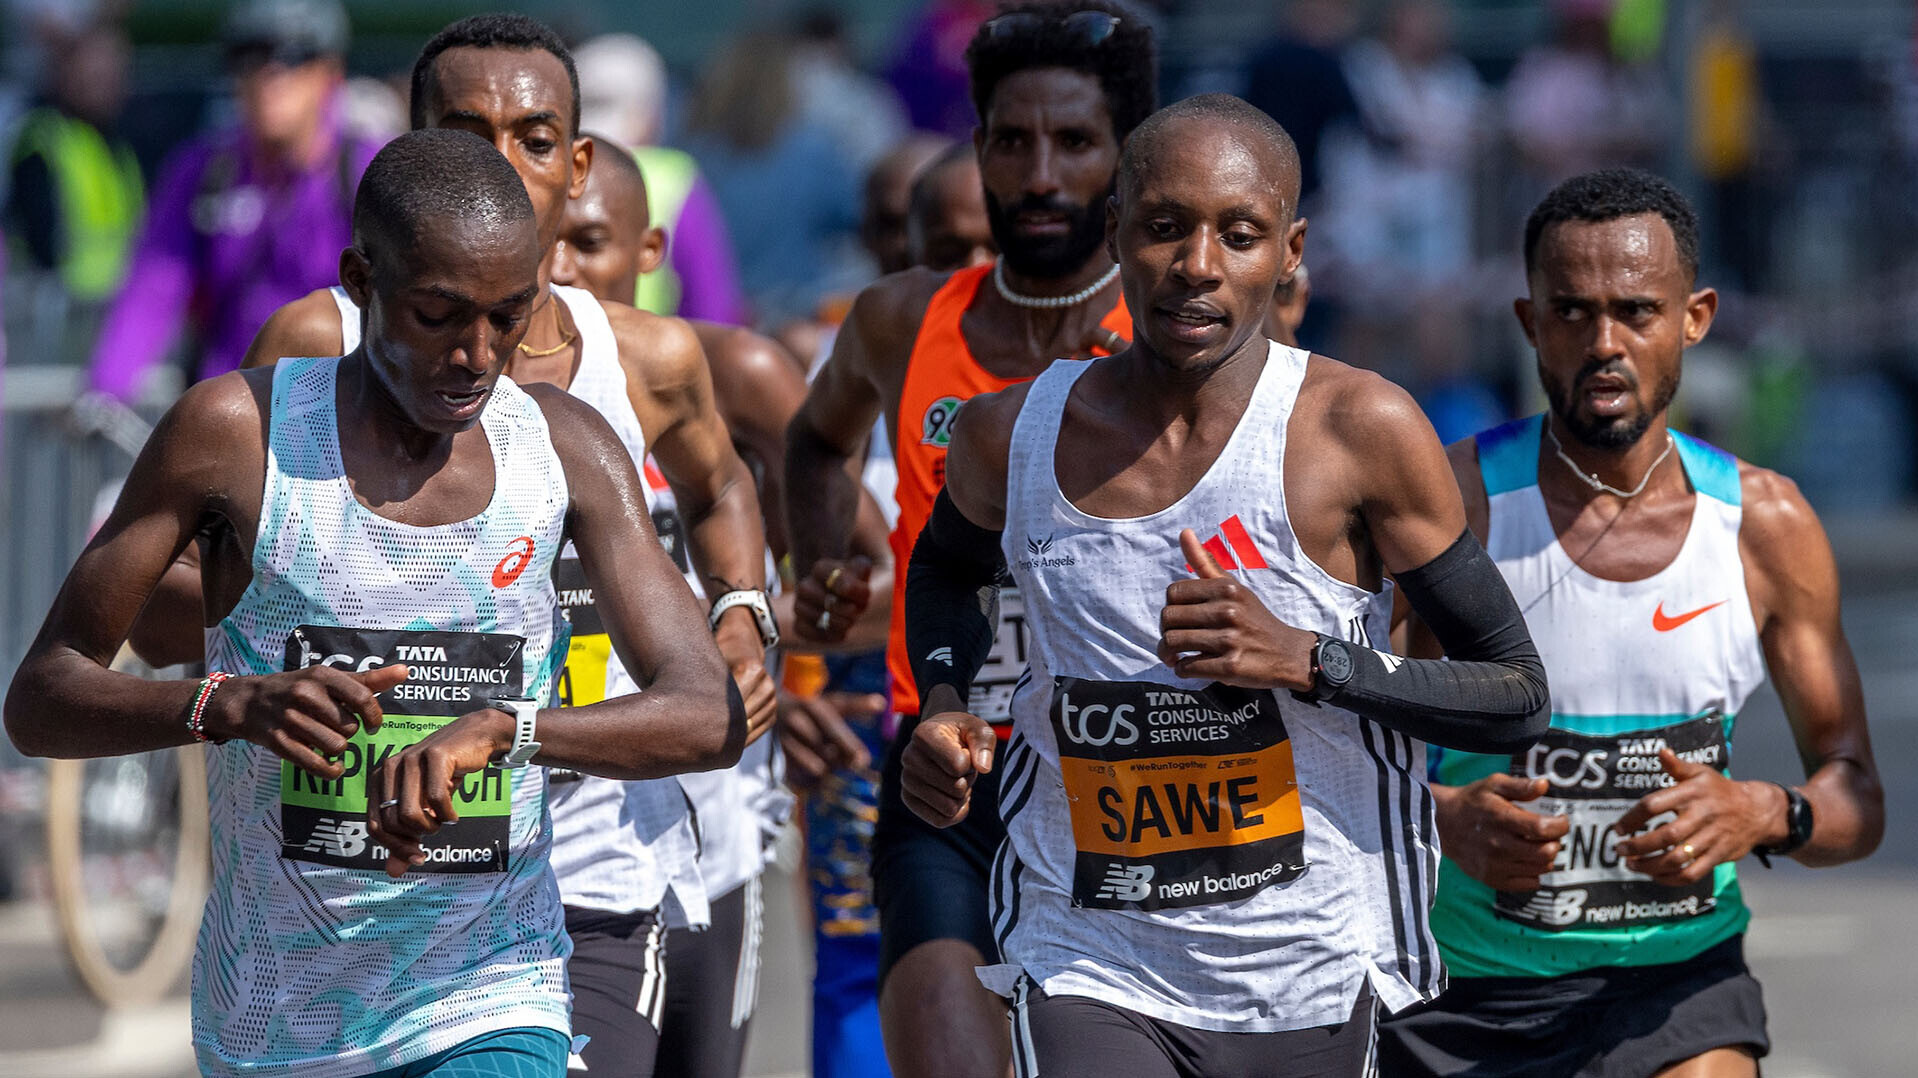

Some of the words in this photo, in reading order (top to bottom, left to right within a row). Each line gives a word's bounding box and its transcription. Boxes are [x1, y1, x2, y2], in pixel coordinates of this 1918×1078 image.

[1040, 555, 1075, 568] Angels
[396, 646, 447, 662] TATA
[406, 665, 510, 685] ONSULTANCY
[393, 684, 471, 702] SERVICES
[1145, 692, 1199, 707] TATA
[1062, 693, 1140, 747] tcs
[1147, 700, 1260, 727] CONSULTANCY
[1150, 725, 1230, 744] SERVICES
[1130, 761, 1208, 772] #WeRunTogether
[1097, 775, 1265, 843] SAWE
[1159, 880, 1201, 899] new
[1204, 862, 1283, 894] balance
[1585, 904, 1624, 923] new
[1624, 895, 1699, 920] balance
